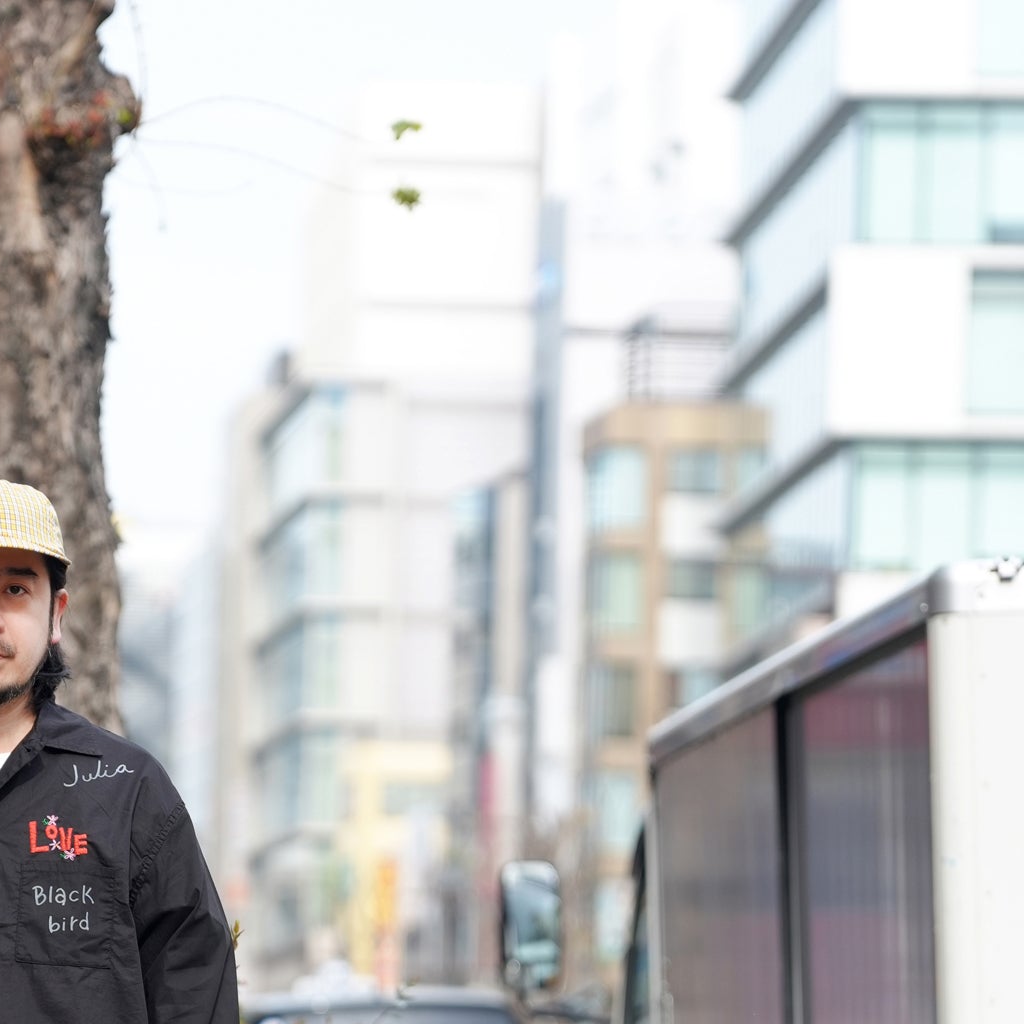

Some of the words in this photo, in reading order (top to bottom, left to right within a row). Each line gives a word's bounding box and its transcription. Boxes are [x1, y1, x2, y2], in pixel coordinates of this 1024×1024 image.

[63, 760, 134, 787] Julia
[32, 885, 94, 906] Black
[48, 912, 90, 933] bird
